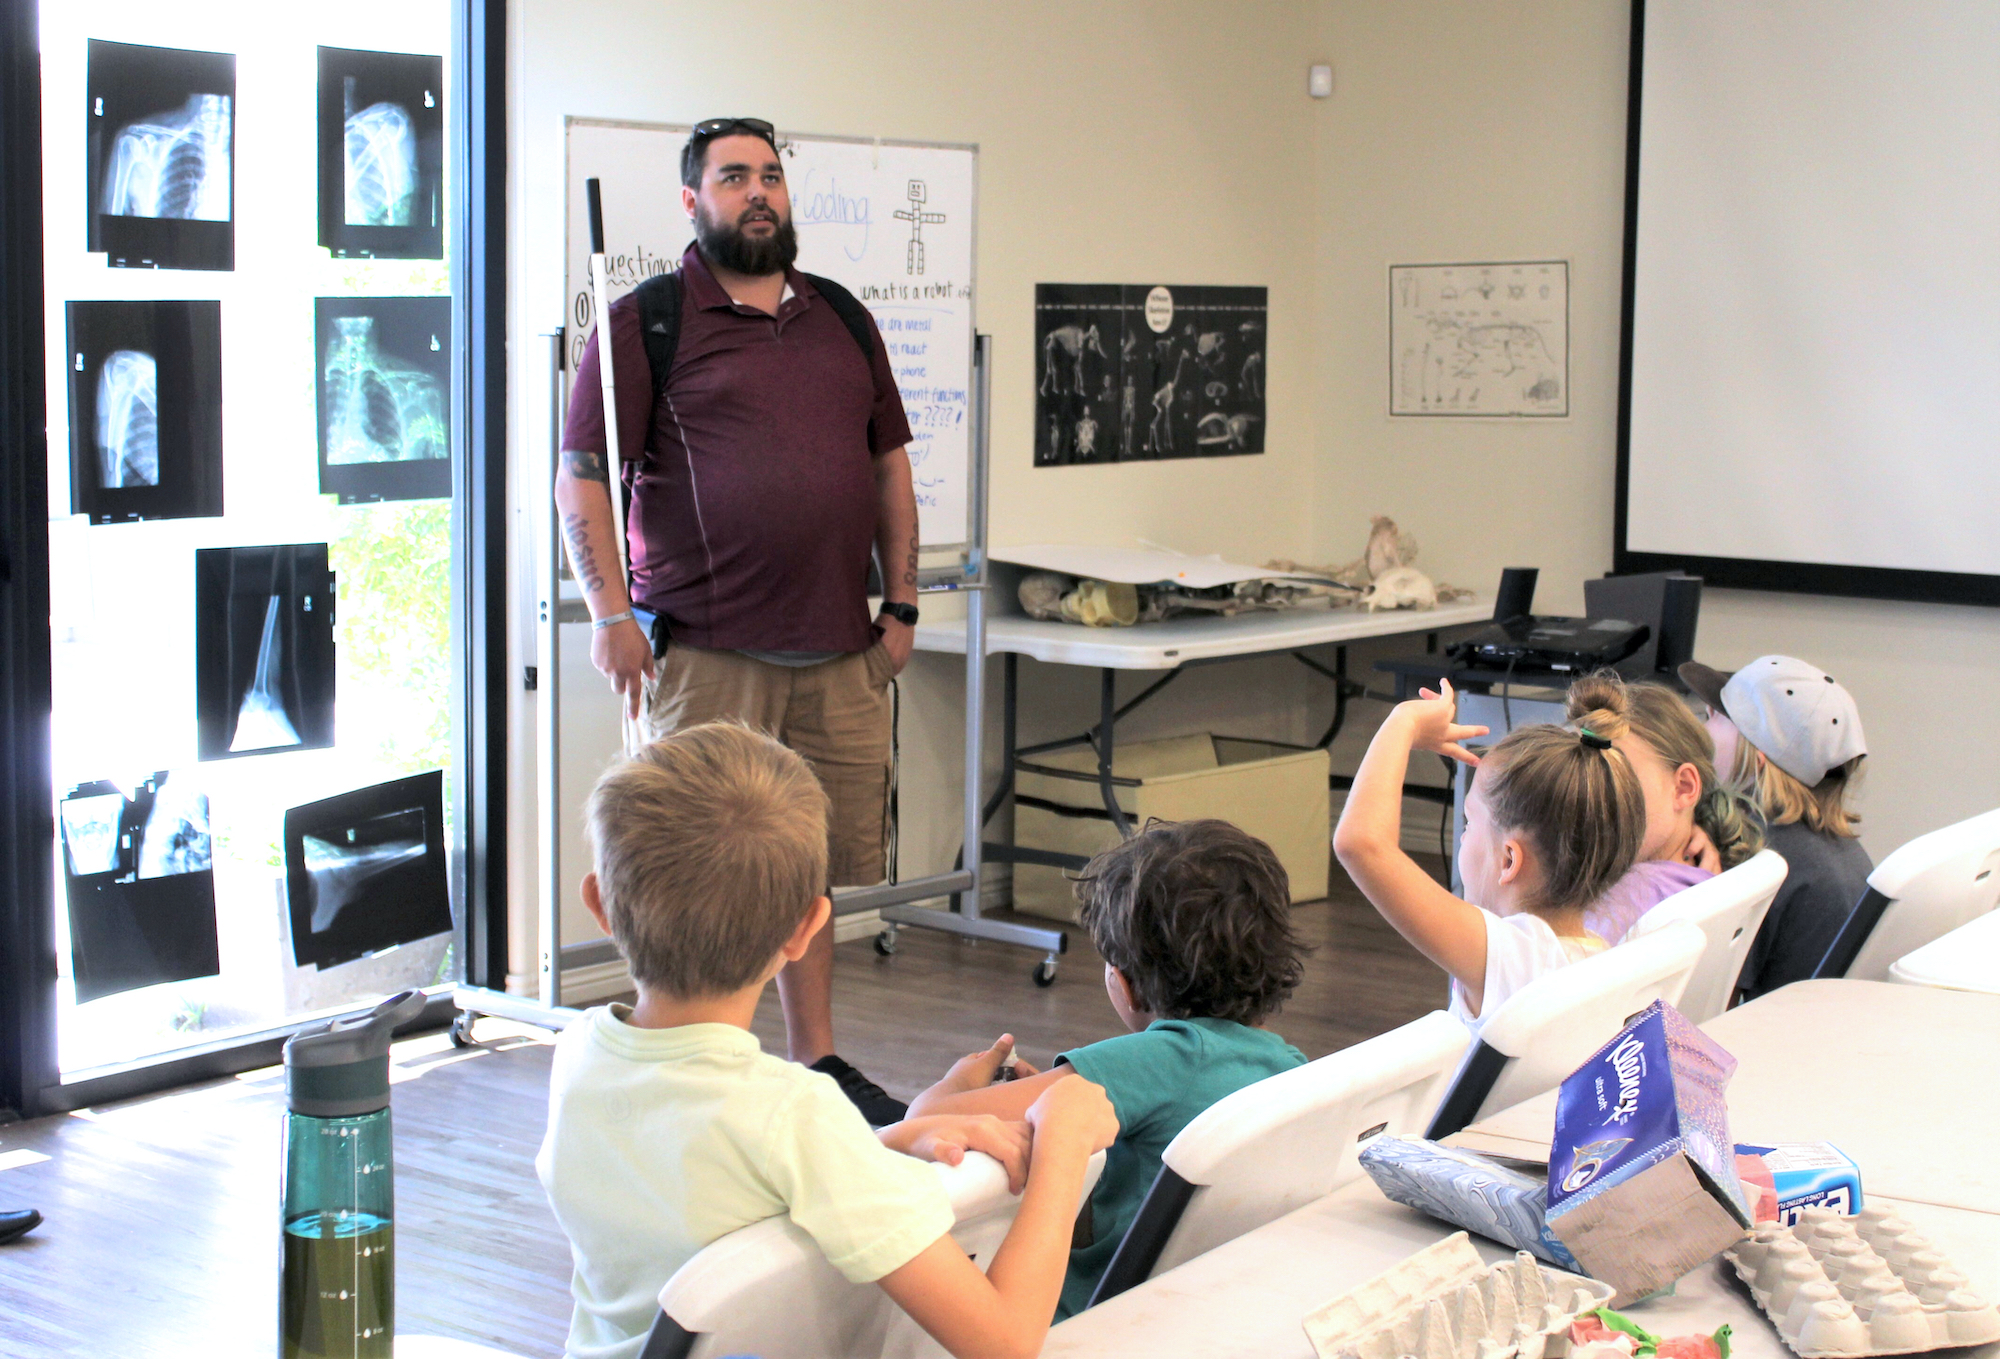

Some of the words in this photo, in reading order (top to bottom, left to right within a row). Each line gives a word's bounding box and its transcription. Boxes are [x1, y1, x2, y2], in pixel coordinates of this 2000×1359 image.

[803, 167, 868, 262] Coding
[913, 287, 920, 300] a
[924, 281, 953, 299] robot
[905, 317, 932, 332] metal
[901, 342, 927, 355] react
[900, 365, 926, 383] phone
[1594, 1076, 1605, 1096] ultra
[1602, 1033, 1645, 1127] Kleenex
[1597, 1094, 1608, 1111] soft
[1808, 1191, 1825, 1203] LONG
